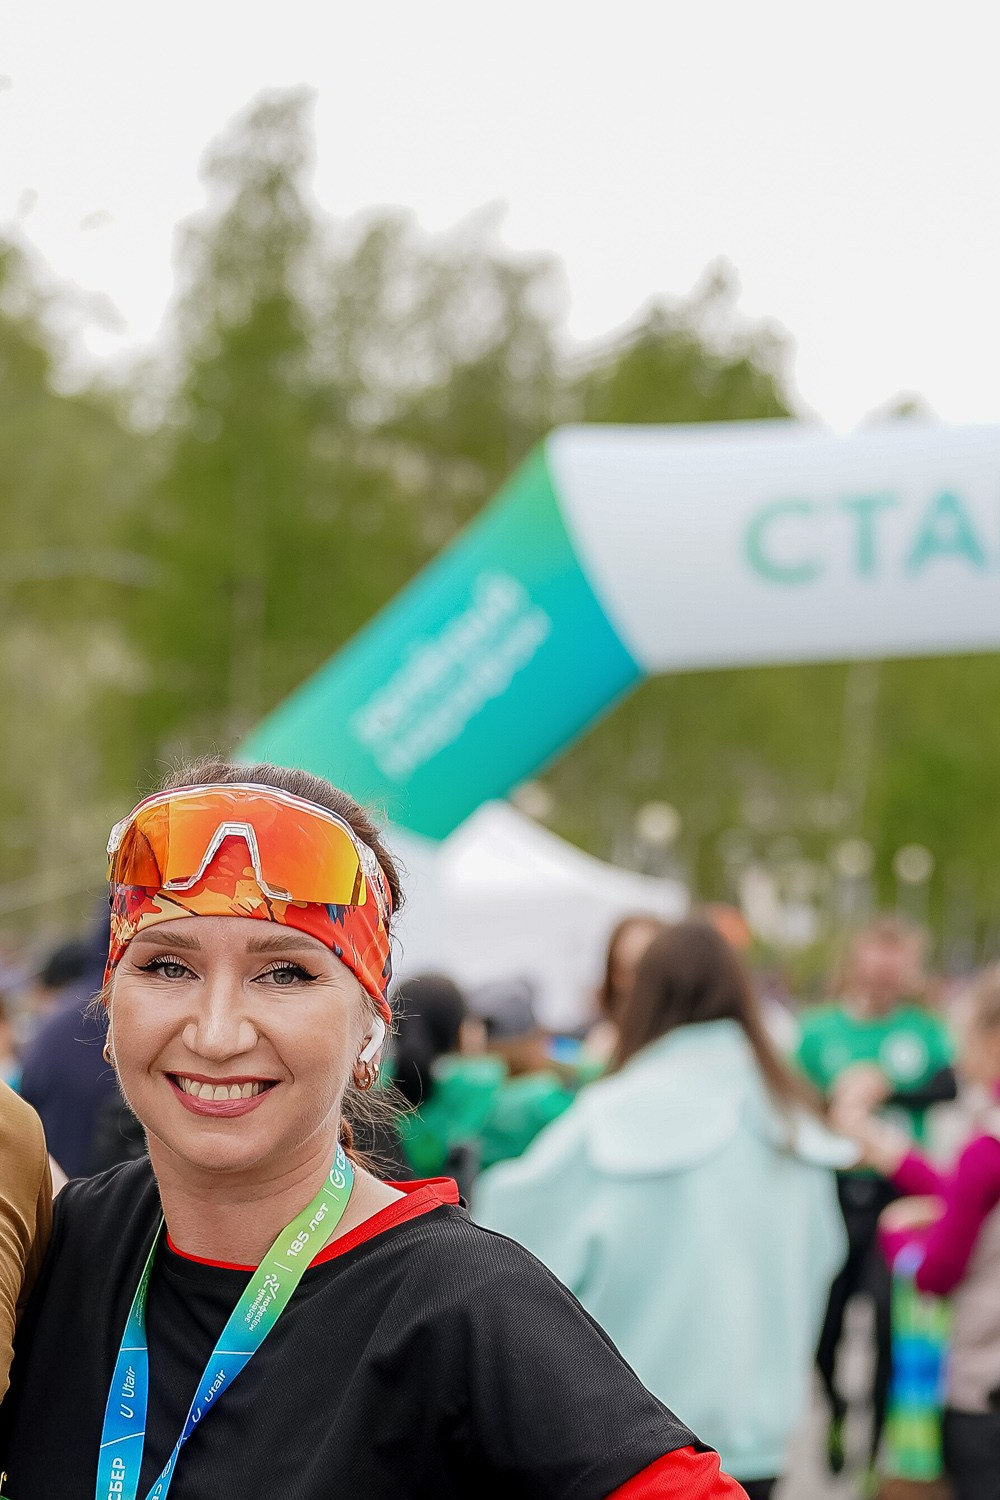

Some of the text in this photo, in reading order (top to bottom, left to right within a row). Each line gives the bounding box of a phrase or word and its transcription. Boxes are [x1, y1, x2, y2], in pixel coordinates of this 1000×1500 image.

[743, 489, 1000, 583] СТА
[286, 1229, 310, 1258] 185
[308, 1202, 330, 1231] лет
[248, 1295, 272, 1332] марафон
[121, 1365, 136, 1399] Utair
[204, 1369, 227, 1403] Utair
